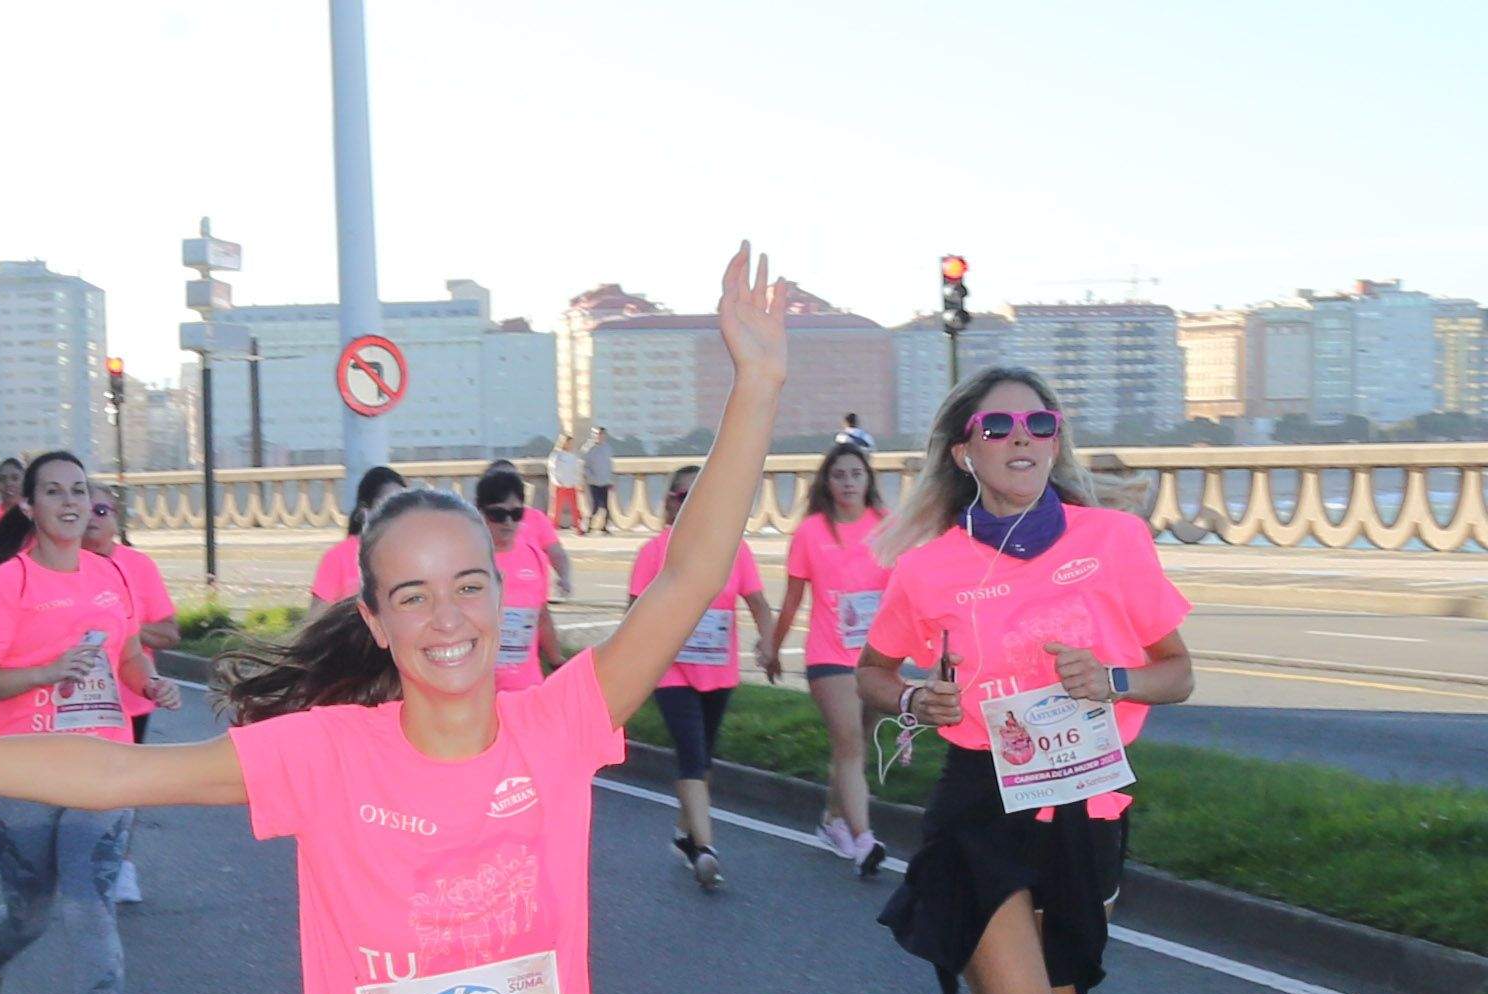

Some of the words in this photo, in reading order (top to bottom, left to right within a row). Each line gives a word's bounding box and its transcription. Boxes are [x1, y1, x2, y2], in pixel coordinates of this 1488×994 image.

[956, 584, 1011, 604] OYSHO
[77, 678, 105, 691] 016
[1038, 728, 1080, 751] 016
[1049, 751, 1077, 768] 1424
[1014, 787, 1054, 802] OYSHO
[359, 804, 438, 836] OYSHO
[359, 947, 417, 981] TU
[508, 977, 544, 993] SUMA
